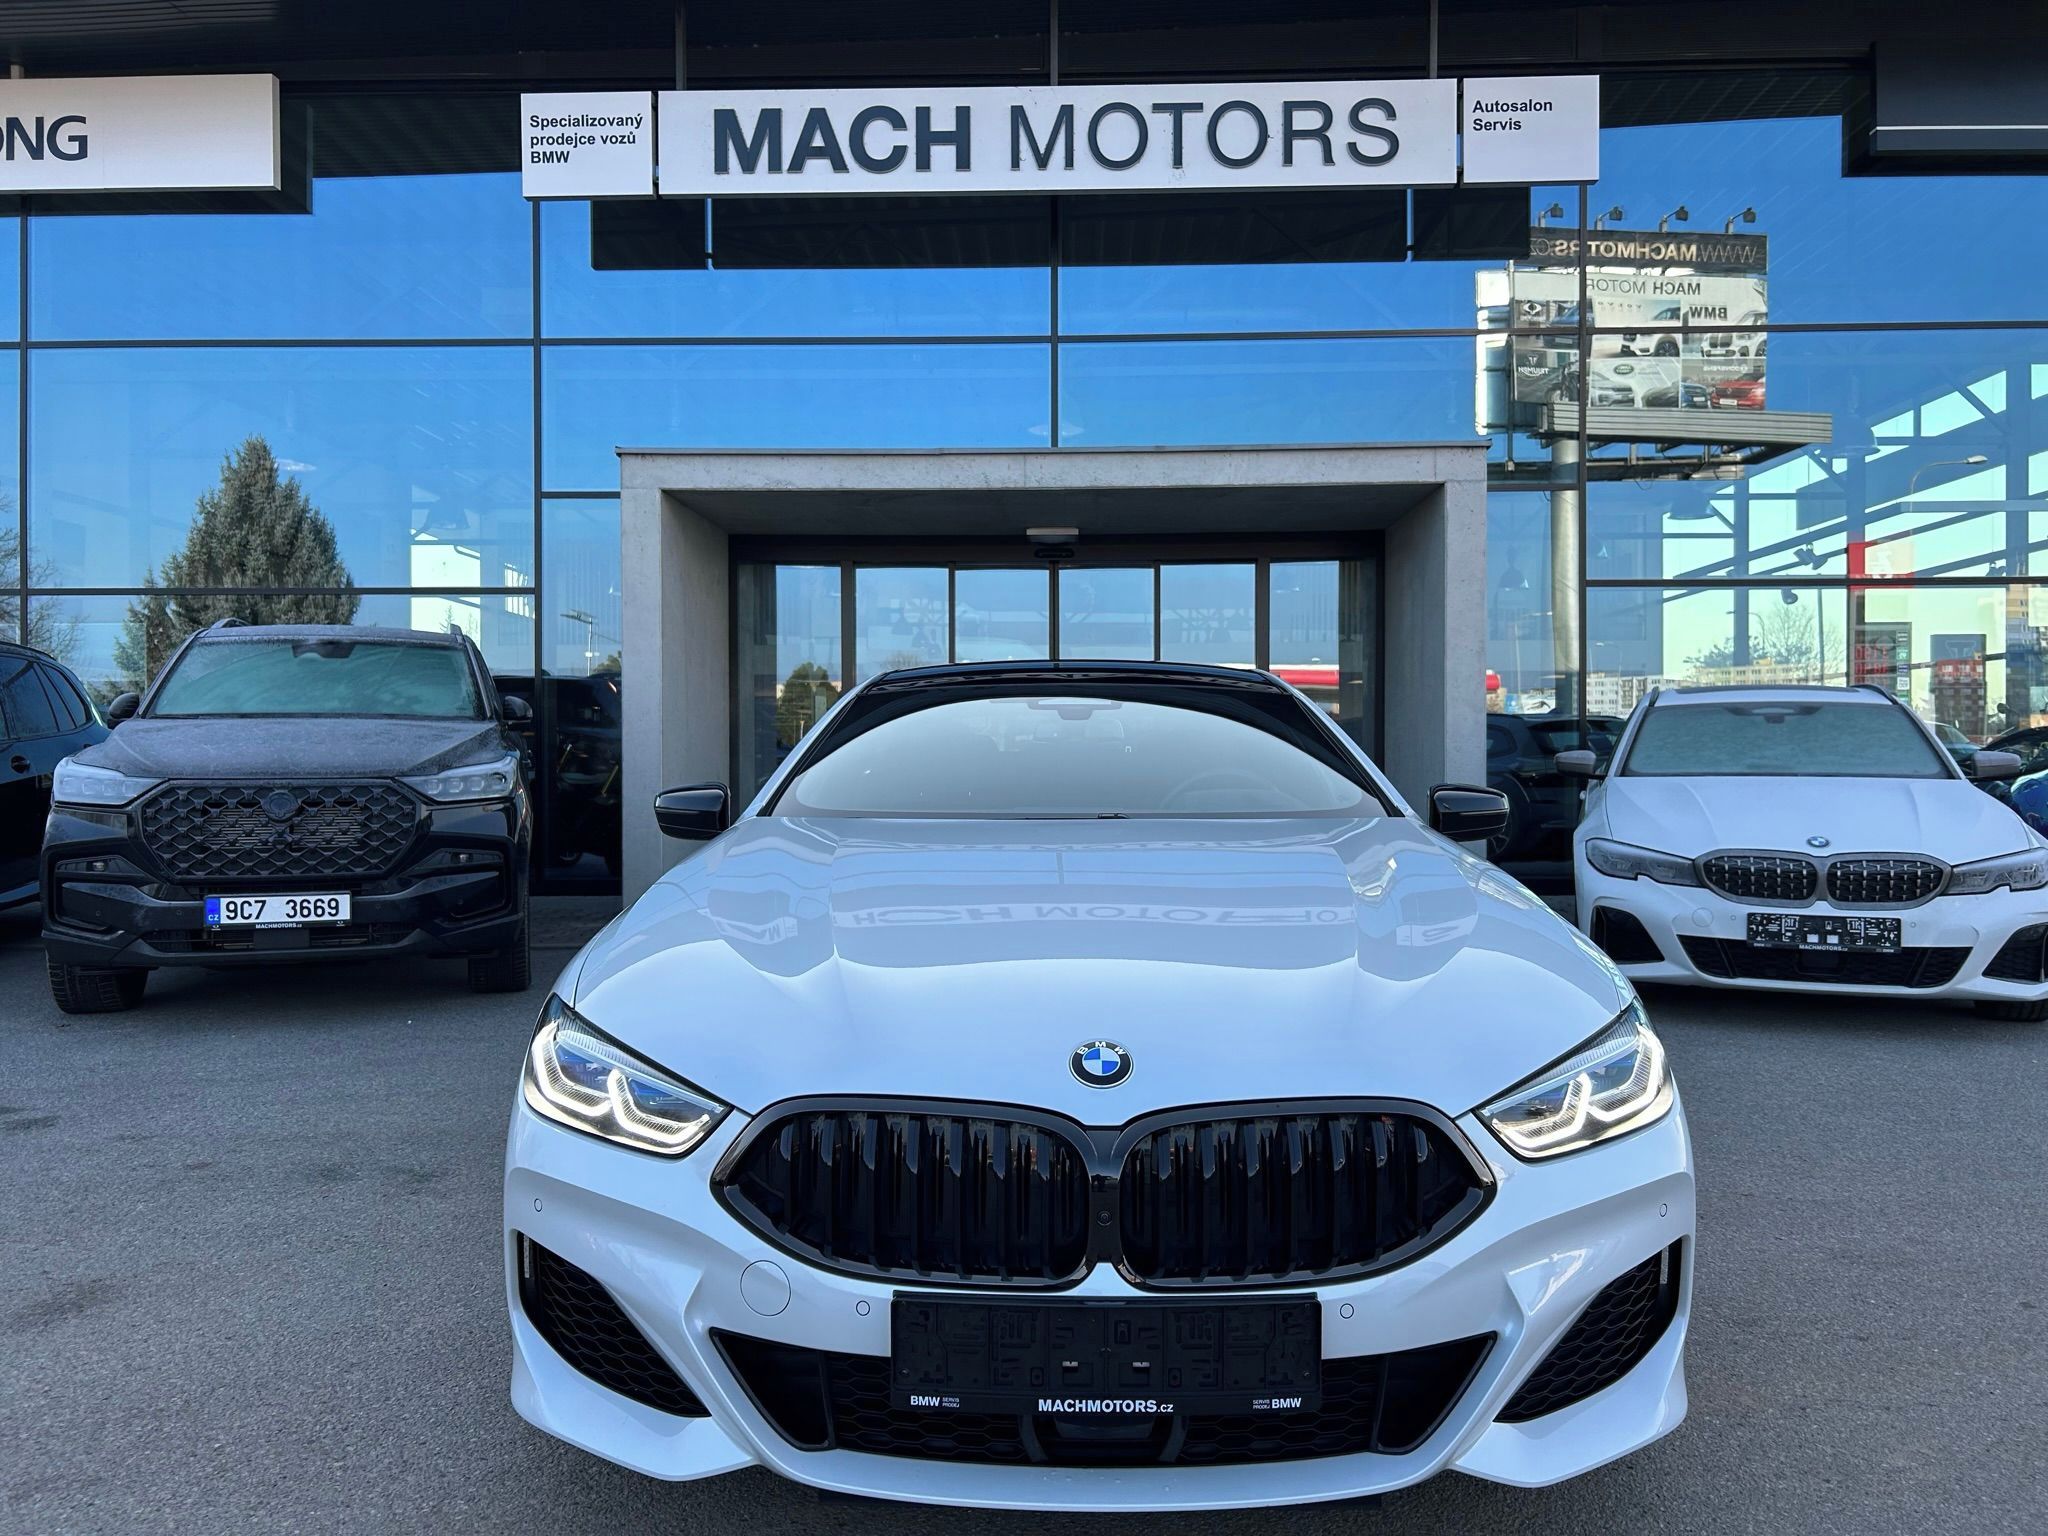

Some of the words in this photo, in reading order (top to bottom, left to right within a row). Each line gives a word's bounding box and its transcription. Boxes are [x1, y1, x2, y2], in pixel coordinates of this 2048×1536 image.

[1472, 99, 1553, 113] Autosalon
[529, 113, 643, 131] Specializovaný
[1472, 117, 1522, 132] Servis
[0, 114, 88, 162] NG
[530, 133, 596, 149] prodejce
[600, 131, 636, 145] vozů
[713, 105, 971, 175] MACH
[1009, 98, 1401, 172] MOTORS
[530, 150, 570, 164] BMW
[225, 900, 267, 920] 9C7
[285, 897, 340, 919] 3669
[1076, 1041, 1127, 1055] BMW
[910, 1395, 940, 1407] BMW
[1038, 1398, 1174, 1413] MACHMOTORS.cz
[1271, 1397, 1302, 1409] BMW
